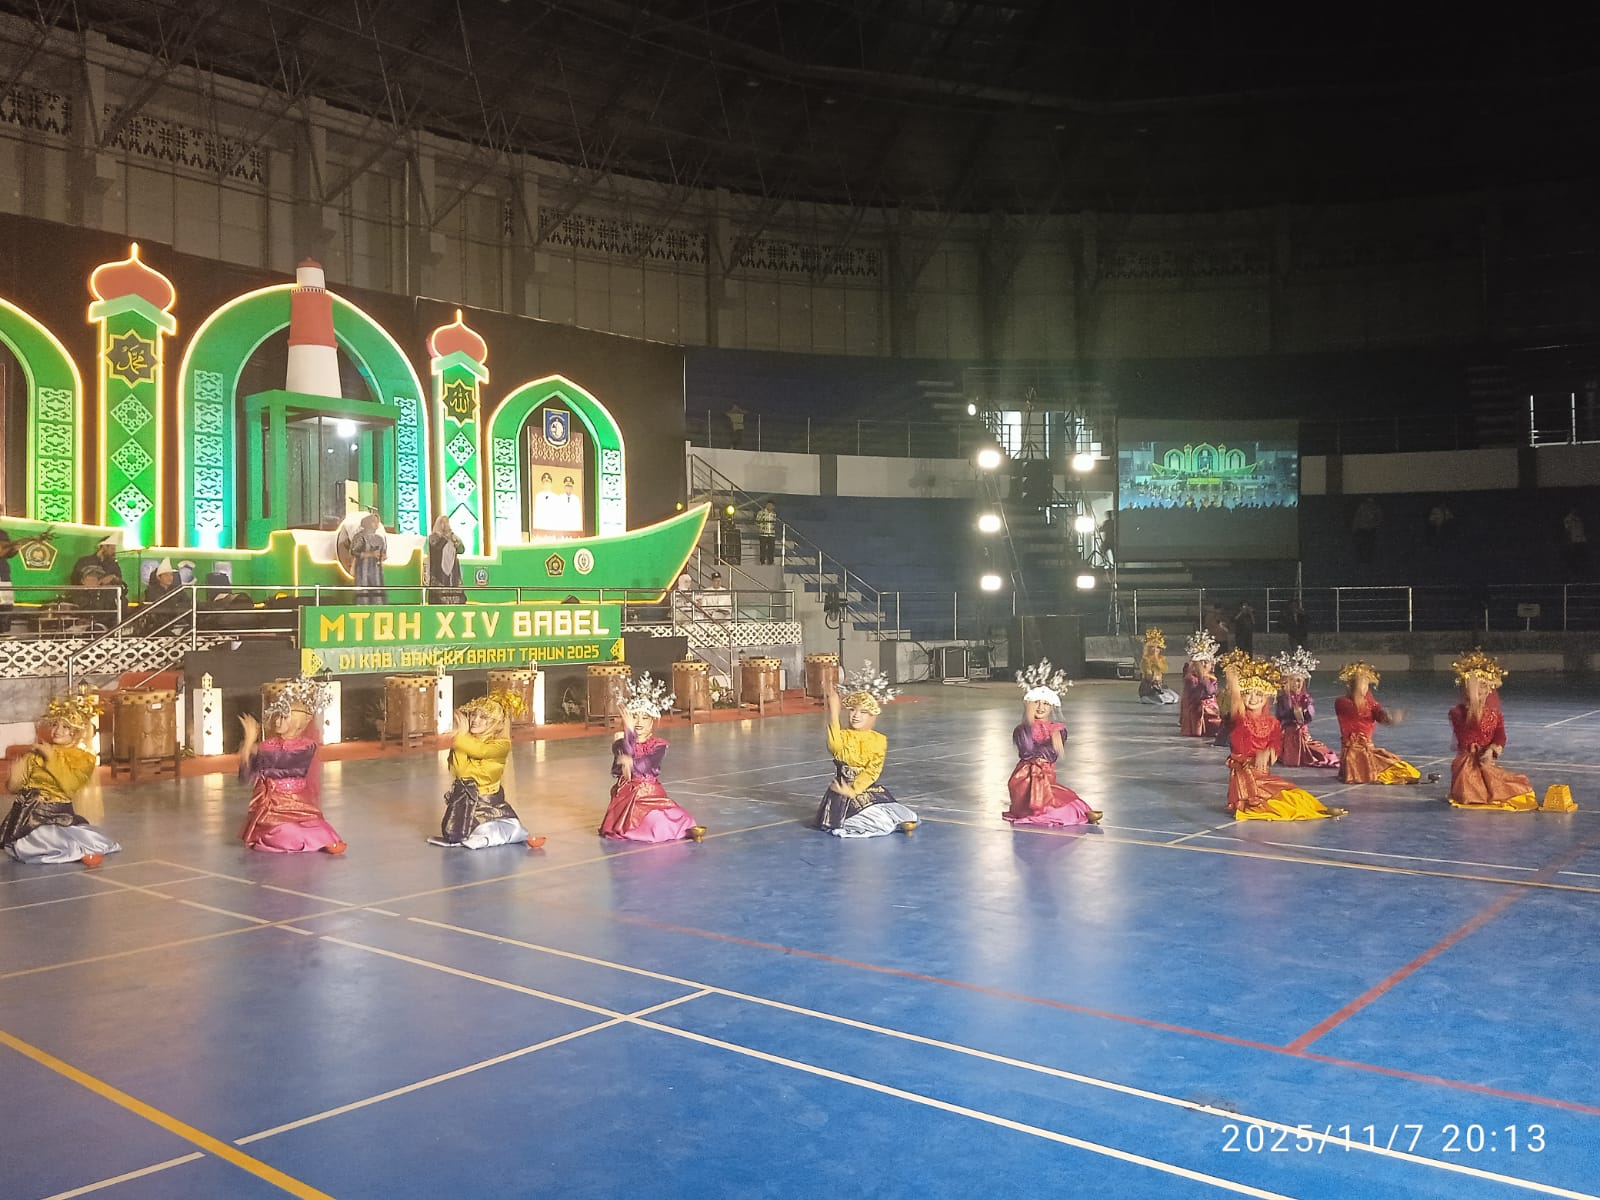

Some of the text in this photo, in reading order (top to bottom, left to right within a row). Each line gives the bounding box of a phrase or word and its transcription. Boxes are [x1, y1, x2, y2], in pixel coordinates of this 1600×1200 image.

[320, 610, 609, 642] MTQH XIV BABEL
[339, 654, 355, 669] DI
[360, 652, 397, 668] KAB.
[467, 648, 515, 664] BARAT
[519, 646, 564, 662] TAHUN
[567, 645, 599, 660] 2025
